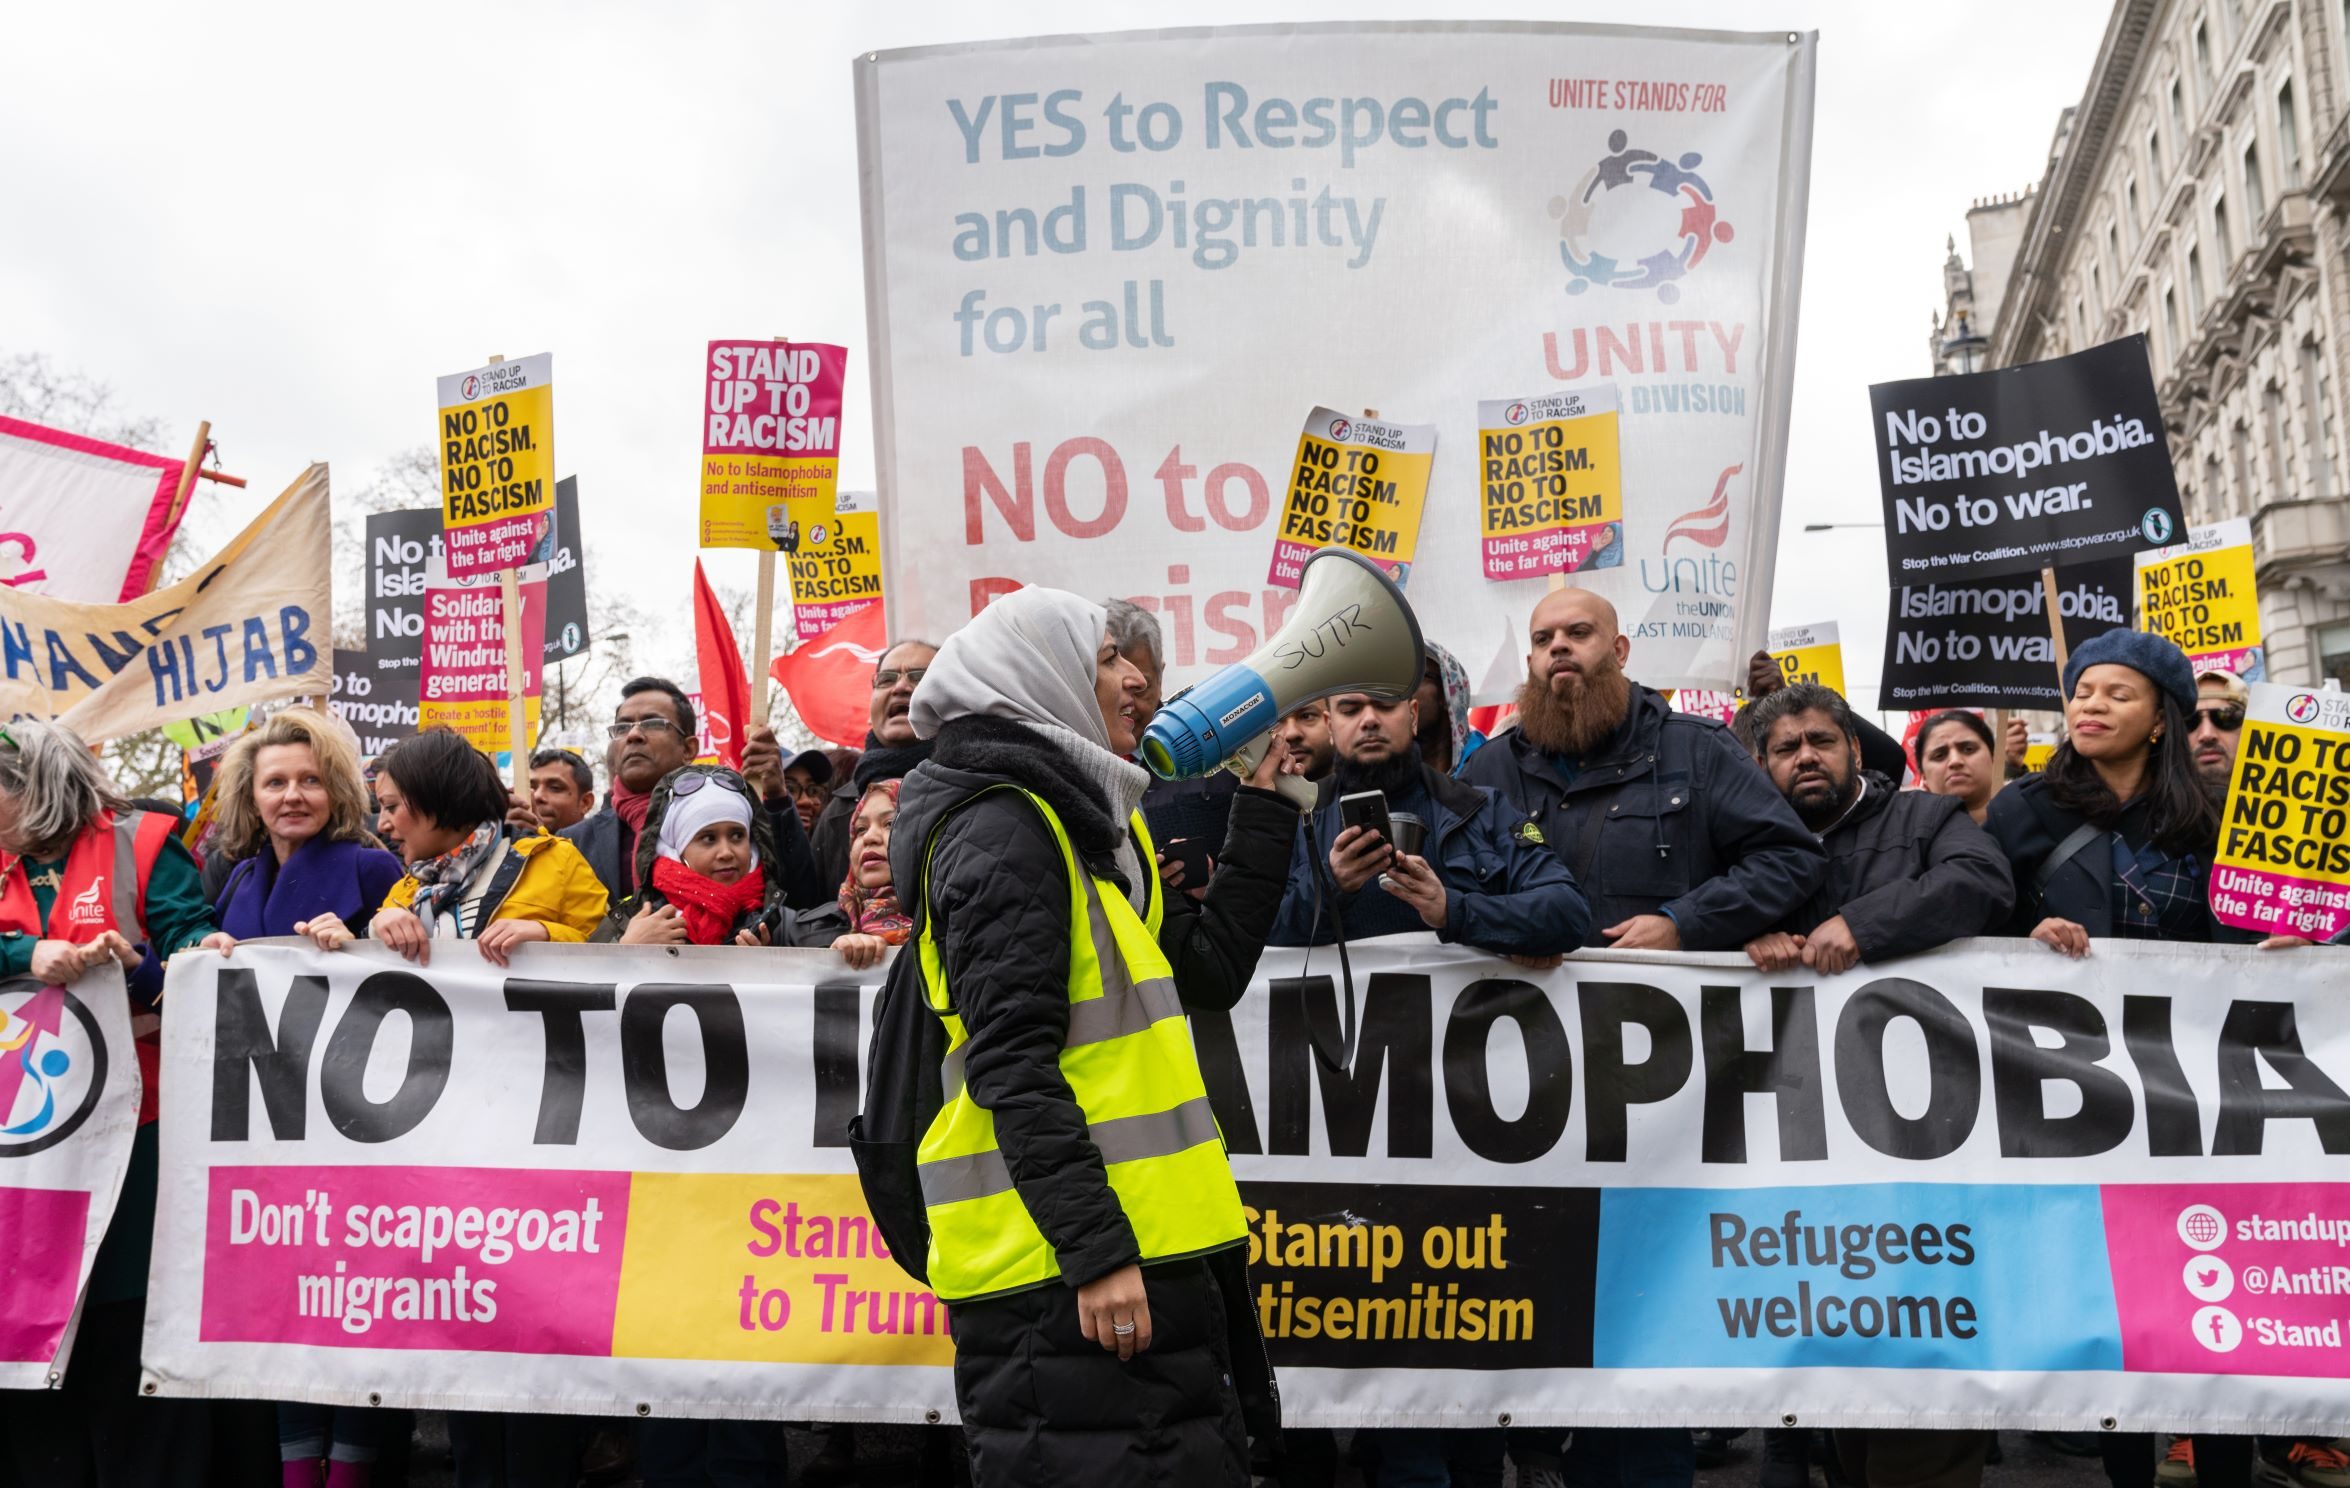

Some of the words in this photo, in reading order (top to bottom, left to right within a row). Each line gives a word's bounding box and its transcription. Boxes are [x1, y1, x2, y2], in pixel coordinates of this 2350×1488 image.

[1549, 79, 1608, 109] UNITE
[1615, 80, 1688, 112] STANDS
[1690, 84, 1727, 112] FOR
[945, 88, 1087, 164] YES
[1102, 92, 1183, 153] to
[1205, 80, 1499, 169] Respect
[952, 185, 1087, 262] and
[1110, 178, 1387, 270] Dignity
[953, 289, 1062, 357] for
[1078, 279, 1175, 350] all
[711, 346, 821, 383] STAND
[1542, 320, 1746, 381] UNITY
[481, 368, 507, 385] STAND
[508, 365, 521, 378] UP
[493, 376, 527, 393] RACISM
[710, 380, 758, 413] UP
[765, 382, 810, 417] TO
[1530, 398, 1562, 412] STAND
[1564, 396, 1580, 408] UP
[1530, 409, 1544, 420] TO
[1546, 405, 1586, 419] RACISM
[1632, 383, 1746, 417] DIVISION
[445, 410, 477, 438] NO
[482, 402, 509, 429] TO
[708, 414, 836, 451] RACISM
[1354, 423, 1386, 437] STAND
[1388, 428, 1403, 439] UP
[1886, 410, 1940, 447] No
[1945, 407, 1987, 441] to
[447, 425, 537, 466] RACISM,
[1302, 441, 1339, 470] NO
[1346, 450, 1379, 475] TO
[1353, 432, 1366, 443] TO
[1367, 435, 1406, 450] RACISM
[1485, 432, 1522, 457] NO
[1529, 426, 1564, 451] TO
[1890, 413, 2154, 485] Islamophobia.
[448, 464, 481, 493] NO
[487, 457, 514, 485] TO
[707, 461, 725, 477] No
[728, 463, 741, 477] to
[745, 462, 833, 483] Islamophobia
[1486, 447, 1595, 482] RACISM,
[450, 479, 543, 520] FASCISM
[706, 480, 729, 495] and
[732, 481, 818, 499] antisemitism
[962, 436, 1129, 546] NO
[1154, 444, 1271, 534] to
[1297, 466, 1400, 507] RACISM,
[1487, 481, 1524, 506] NO
[1532, 474, 1567, 498] TO
[1290, 489, 1329, 517] NO
[1338, 498, 1370, 523] TO
[1487, 494, 1602, 531] FASCISM
[1895, 497, 1950, 534] No
[1955, 494, 1998, 527] to
[2003, 480, 2092, 521] war.
[375, 535, 424, 566] No
[451, 529, 487, 549] Unite
[490, 519, 533, 542] against
[1285, 513, 1398, 554] FASCISM
[1488, 537, 1529, 557] Unite
[1533, 530, 1587, 552] against
[1902, 557, 1929, 570] Stop
[1931, 555, 1948, 568] the
[1949, 552, 1971, 564] War
[1973, 545, 2028, 562] Coalition.
[2029, 525, 2141, 555] www.stopwar.org.uk
[2204, 529, 2217, 539] UP
[452, 552, 473, 568] the
[477, 548, 495, 563] far
[497, 541, 527, 562] right
[791, 561, 819, 579] NO
[823, 558, 852, 577] TO
[1279, 543, 1312, 562] Unit
[1488, 556, 1514, 574] the
[1518, 552, 1539, 570] far
[1543, 548, 1578, 569] right
[794, 574, 881, 599] FASCISM
[1275, 562, 1300, 580] the
[1641, 552, 1736, 598] unite
[2145, 567, 2170, 591] NO
[2174, 559, 2204, 582] TO
[2147, 577, 2234, 612] RACISM,
[376, 607, 424, 639] No
[797, 606, 828, 619] Unite
[800, 621, 819, 634] the
[2148, 611, 2175, 632] NO
[2180, 604, 2209, 626] TO
[431, 619, 476, 643] with
[1273, 603, 1373, 670] SUTR
[1626, 622, 1668, 639] EAST
[1672, 622, 1734, 642] MIDLANDS
[1783, 637, 1815, 648] RACISM
[1797, 628, 1810, 638] UP
[1896, 630, 1941, 665] No
[1945, 629, 1980, 661] to
[147, 605, 318, 707] HIJAB
[378, 658, 401, 669] Stop
[402, 656, 419, 667] the
[430, 643, 508, 668] Windru
[346, 672, 372, 696] to
[425, 669, 531, 698] generatn
[1892, 686, 1917, 699] Stop
[1917, 685, 1931, 697] the
[1932, 684, 1949, 696] War
[1950, 683, 2000, 695] Coalition.
[426, 707, 462, 720] Create
[464, 711, 471, 720] a
[2322, 713, 2341, 728] TO
[2324, 699, 2350, 714] STA
[494, 720, 507, 734] for
[2246, 729, 2302, 764] NO
[2313, 738, 2350, 772] TO
[2239, 763, 2350, 806] RACIS
[2232, 795, 2288, 830] NO
[2300, 804, 2347, 840] TO
[2226, 828, 2350, 875] FASCIS
[2218, 869, 2274, 897] Unite
[2279, 881, 2350, 911] against
[2214, 892, 2247, 917] the
[2253, 900, 2283, 922] far
[2287, 904, 2336, 934] right
[211, 968, 454, 1145] NO
[504, 978, 750, 1151] TO
[344, 1197, 603, 1264] scapegoat
[1245, 1206, 1403, 1284] Stamp
[1422, 1213, 1507, 1270] out
[1710, 1211, 1976, 1280] Refugees
[2236, 1212, 2350, 1248] standup
[298, 1260, 497, 1333] migrants
[2243, 1265, 2350, 1295] @AntiR
[740, 1274, 792, 1331] to
[813, 1273, 951, 1335] Trum
[1257, 1281, 1533, 1342] tisemitism
[1717, 1281, 1979, 1340] welcome
